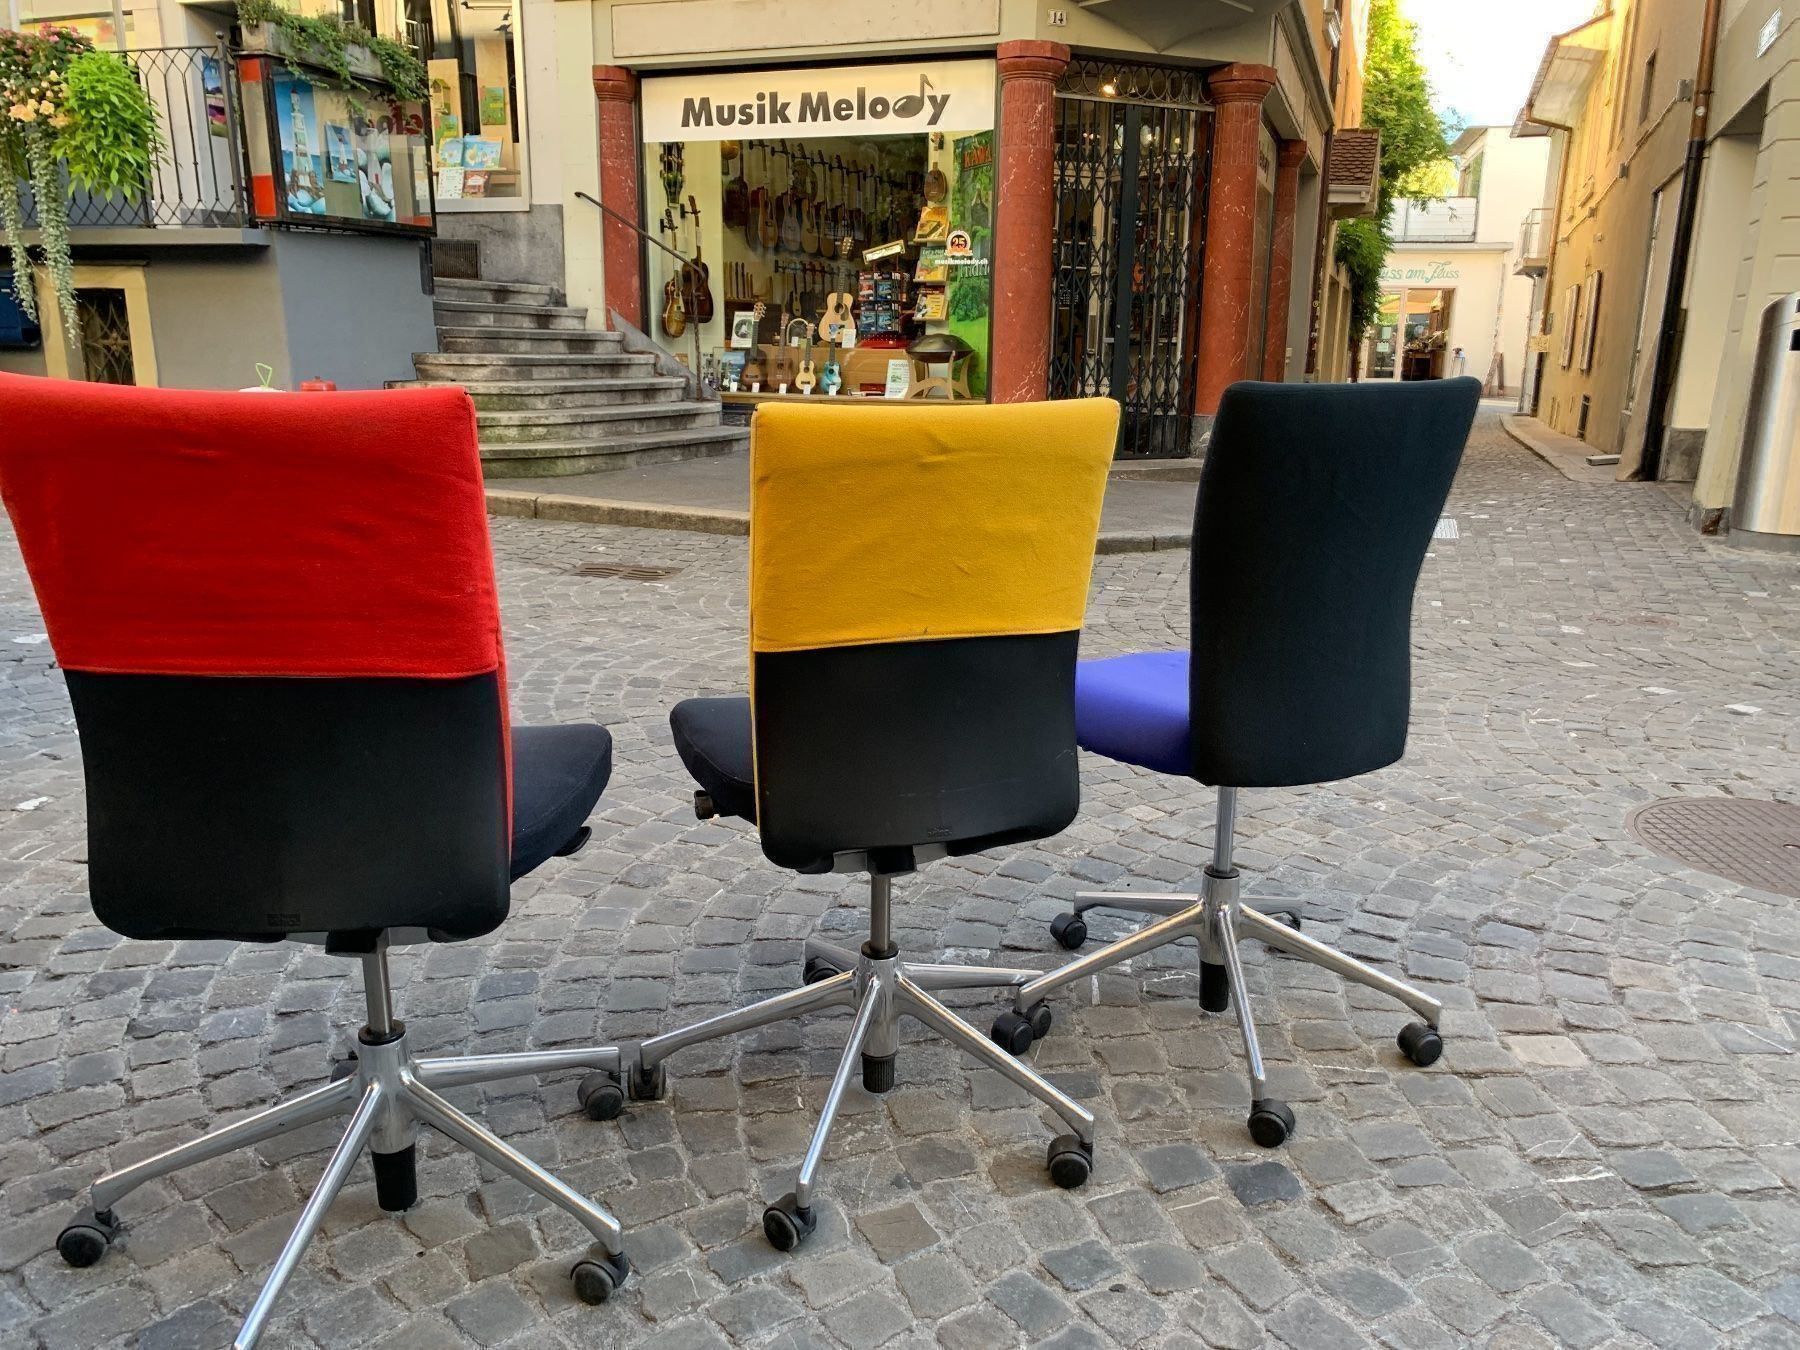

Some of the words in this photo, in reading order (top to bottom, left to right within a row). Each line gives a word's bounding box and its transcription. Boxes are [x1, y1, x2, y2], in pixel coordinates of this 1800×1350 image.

[1052, 12, 1064, 24] 14
[681, 91, 791, 127] Musik
[798, 73, 951, 126] Melody
[1405, 269, 1425, 279] am
[1424, 261, 1459, 283] Fluss
